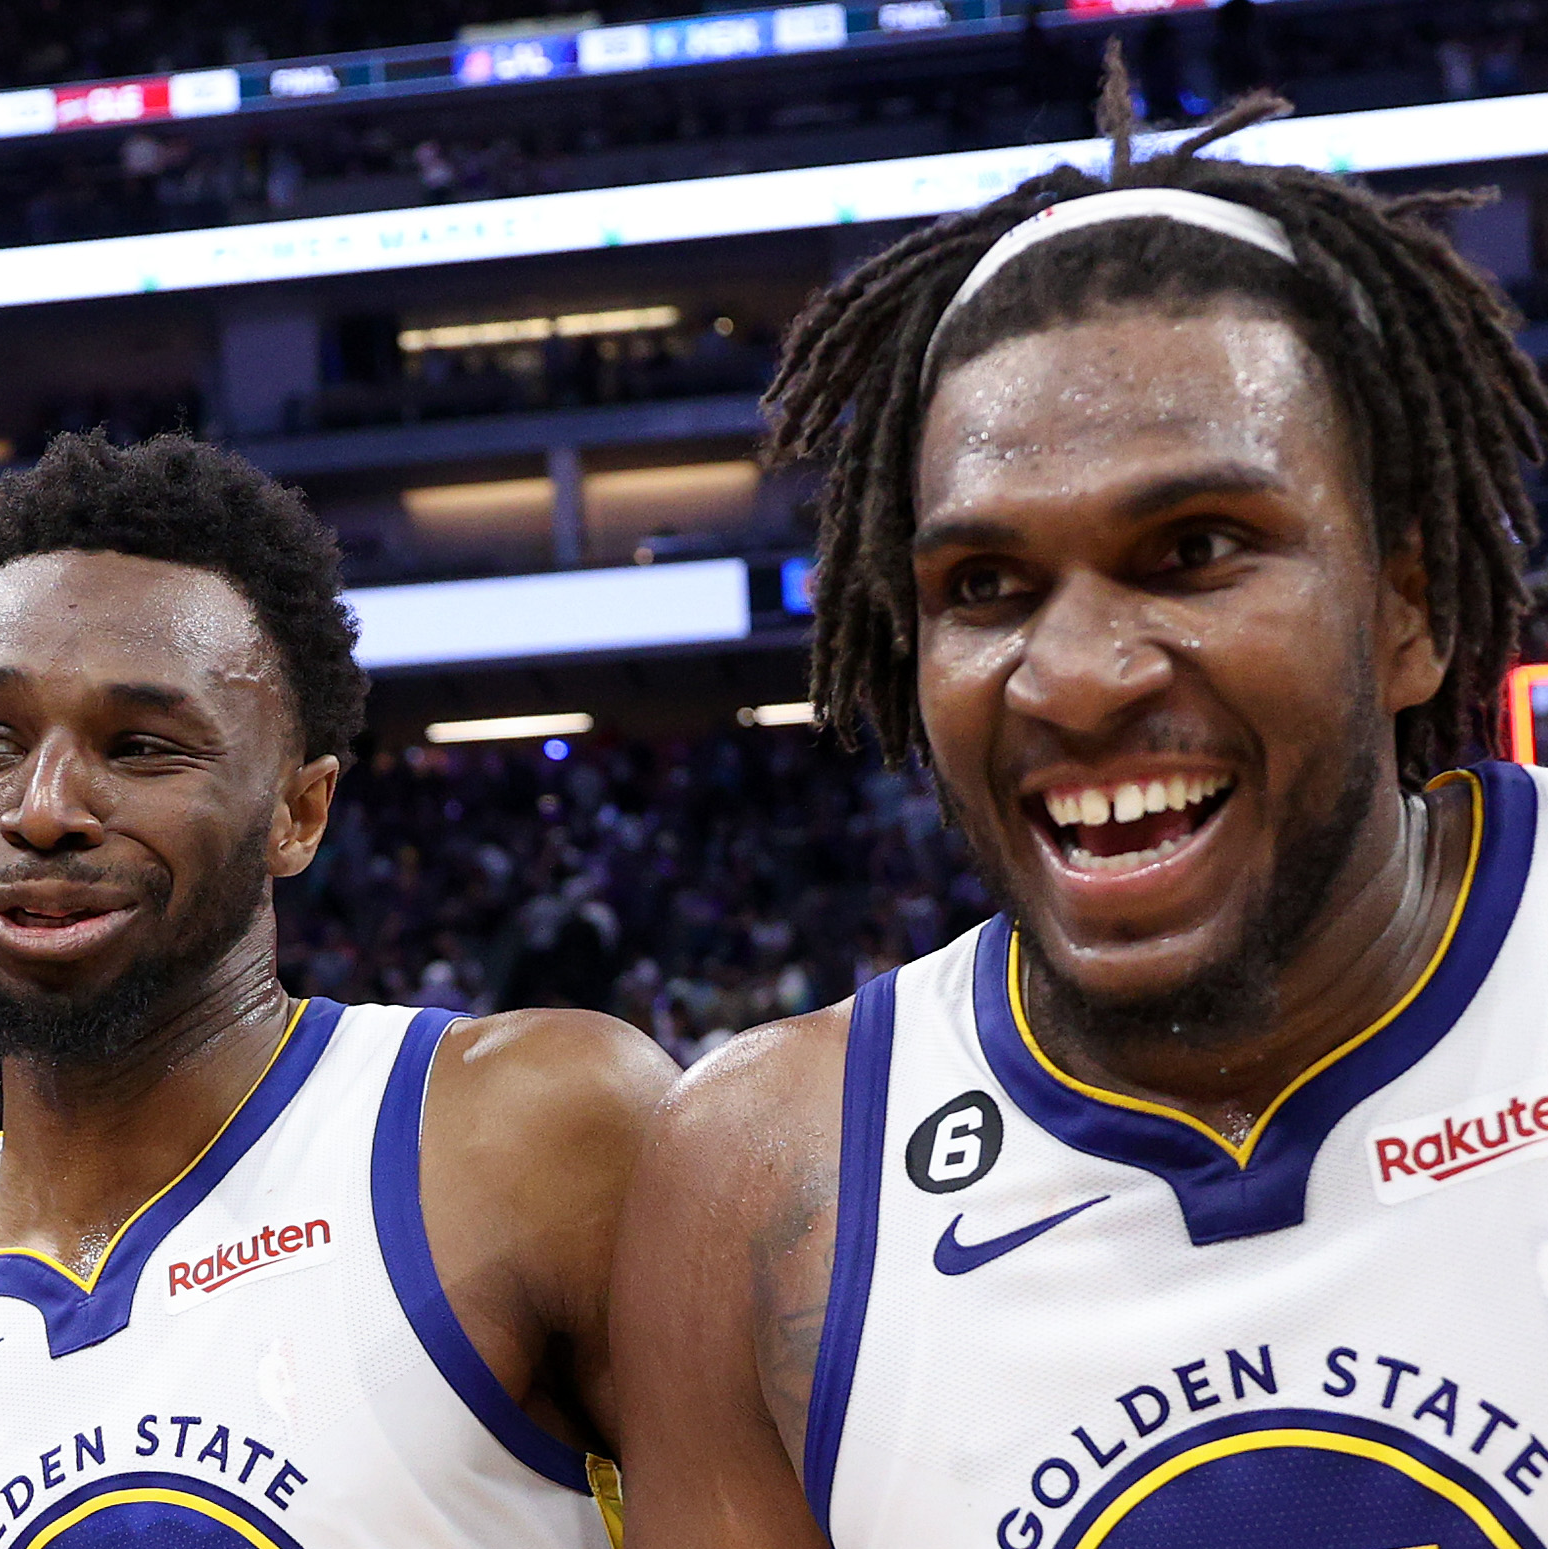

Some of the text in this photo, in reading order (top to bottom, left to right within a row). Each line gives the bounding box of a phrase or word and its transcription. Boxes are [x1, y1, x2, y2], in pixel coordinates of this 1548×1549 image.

[927, 1110, 982, 1180] 6
[168, 1218, 332, 1297] Rakuten
[135, 1413, 308, 1512] STATE
